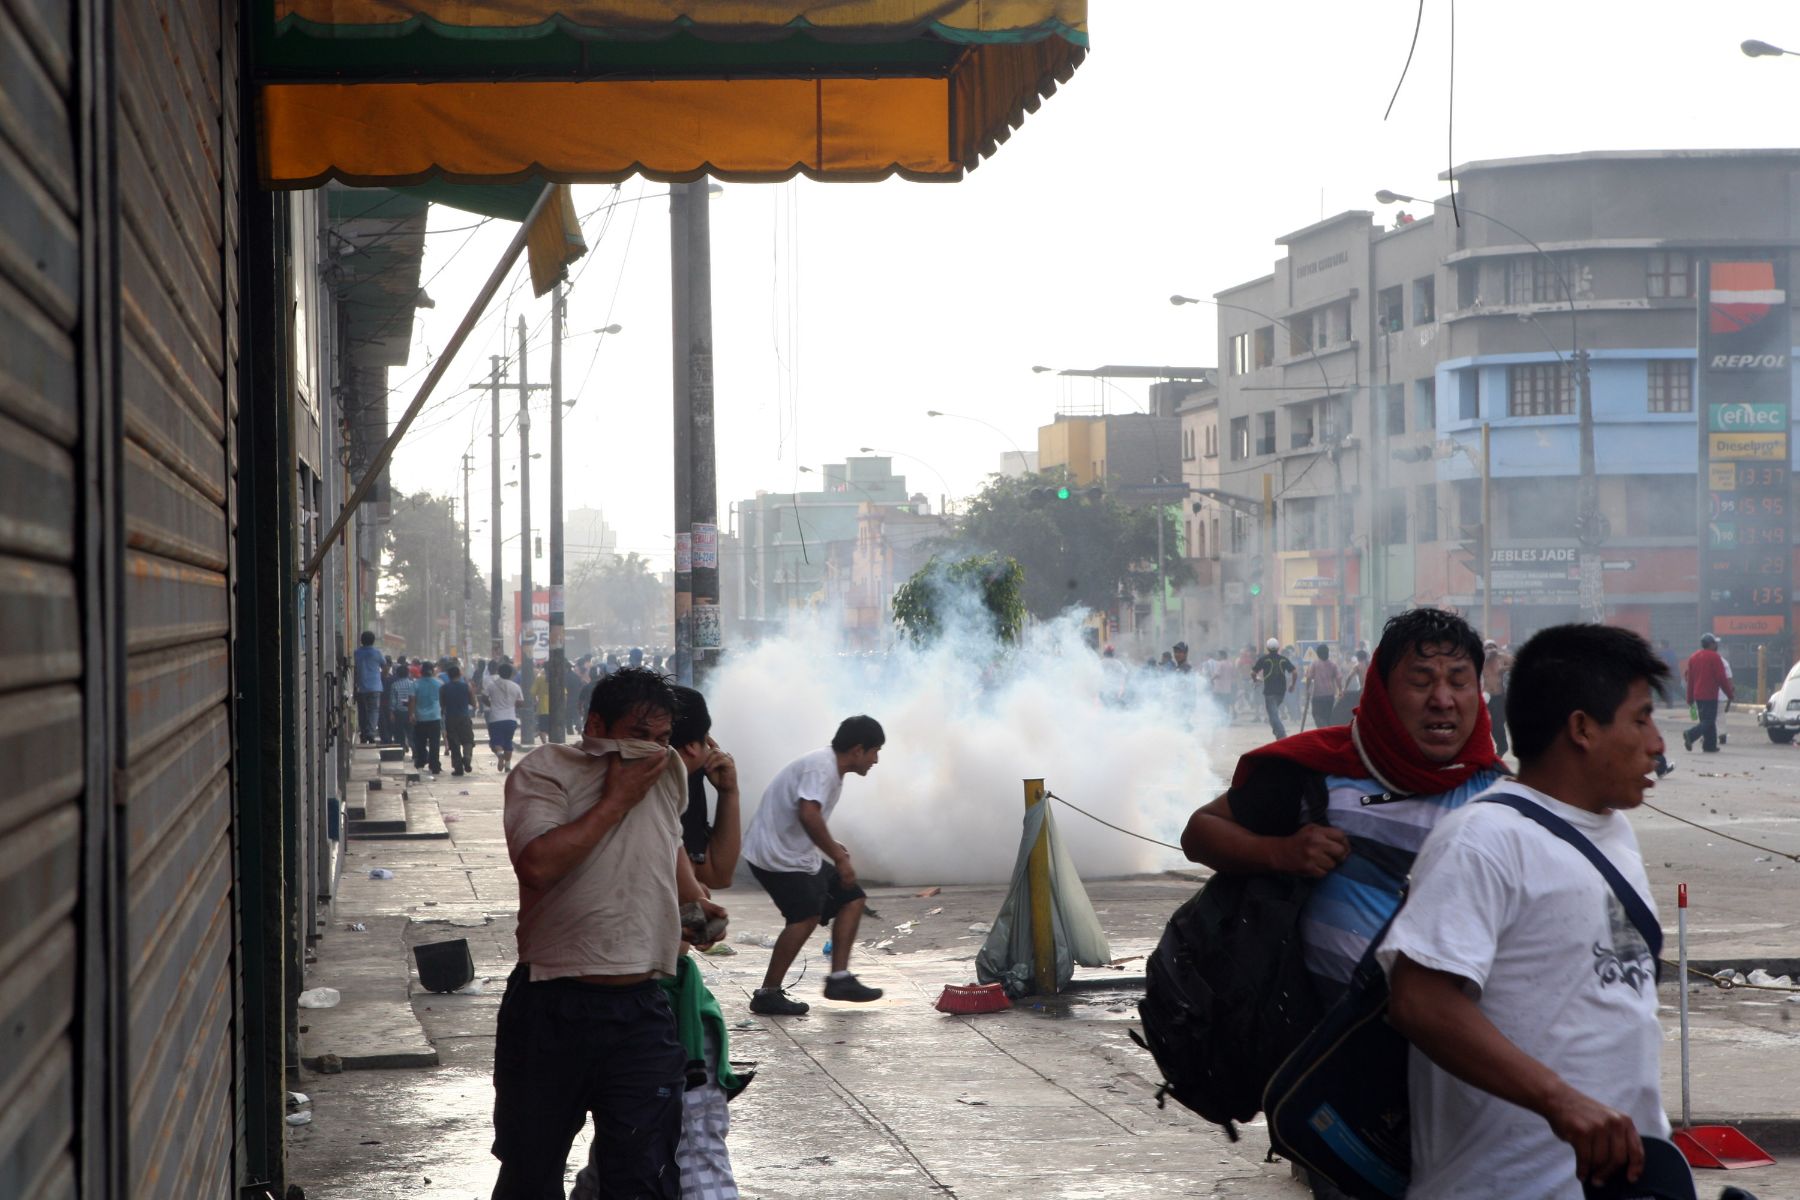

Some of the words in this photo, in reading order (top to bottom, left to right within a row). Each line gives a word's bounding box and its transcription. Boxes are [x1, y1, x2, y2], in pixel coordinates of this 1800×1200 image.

[1711, 354, 1785, 368] REPSOL
[1721, 501, 1735, 511] 95
[1539, 549, 1576, 561] JADE
